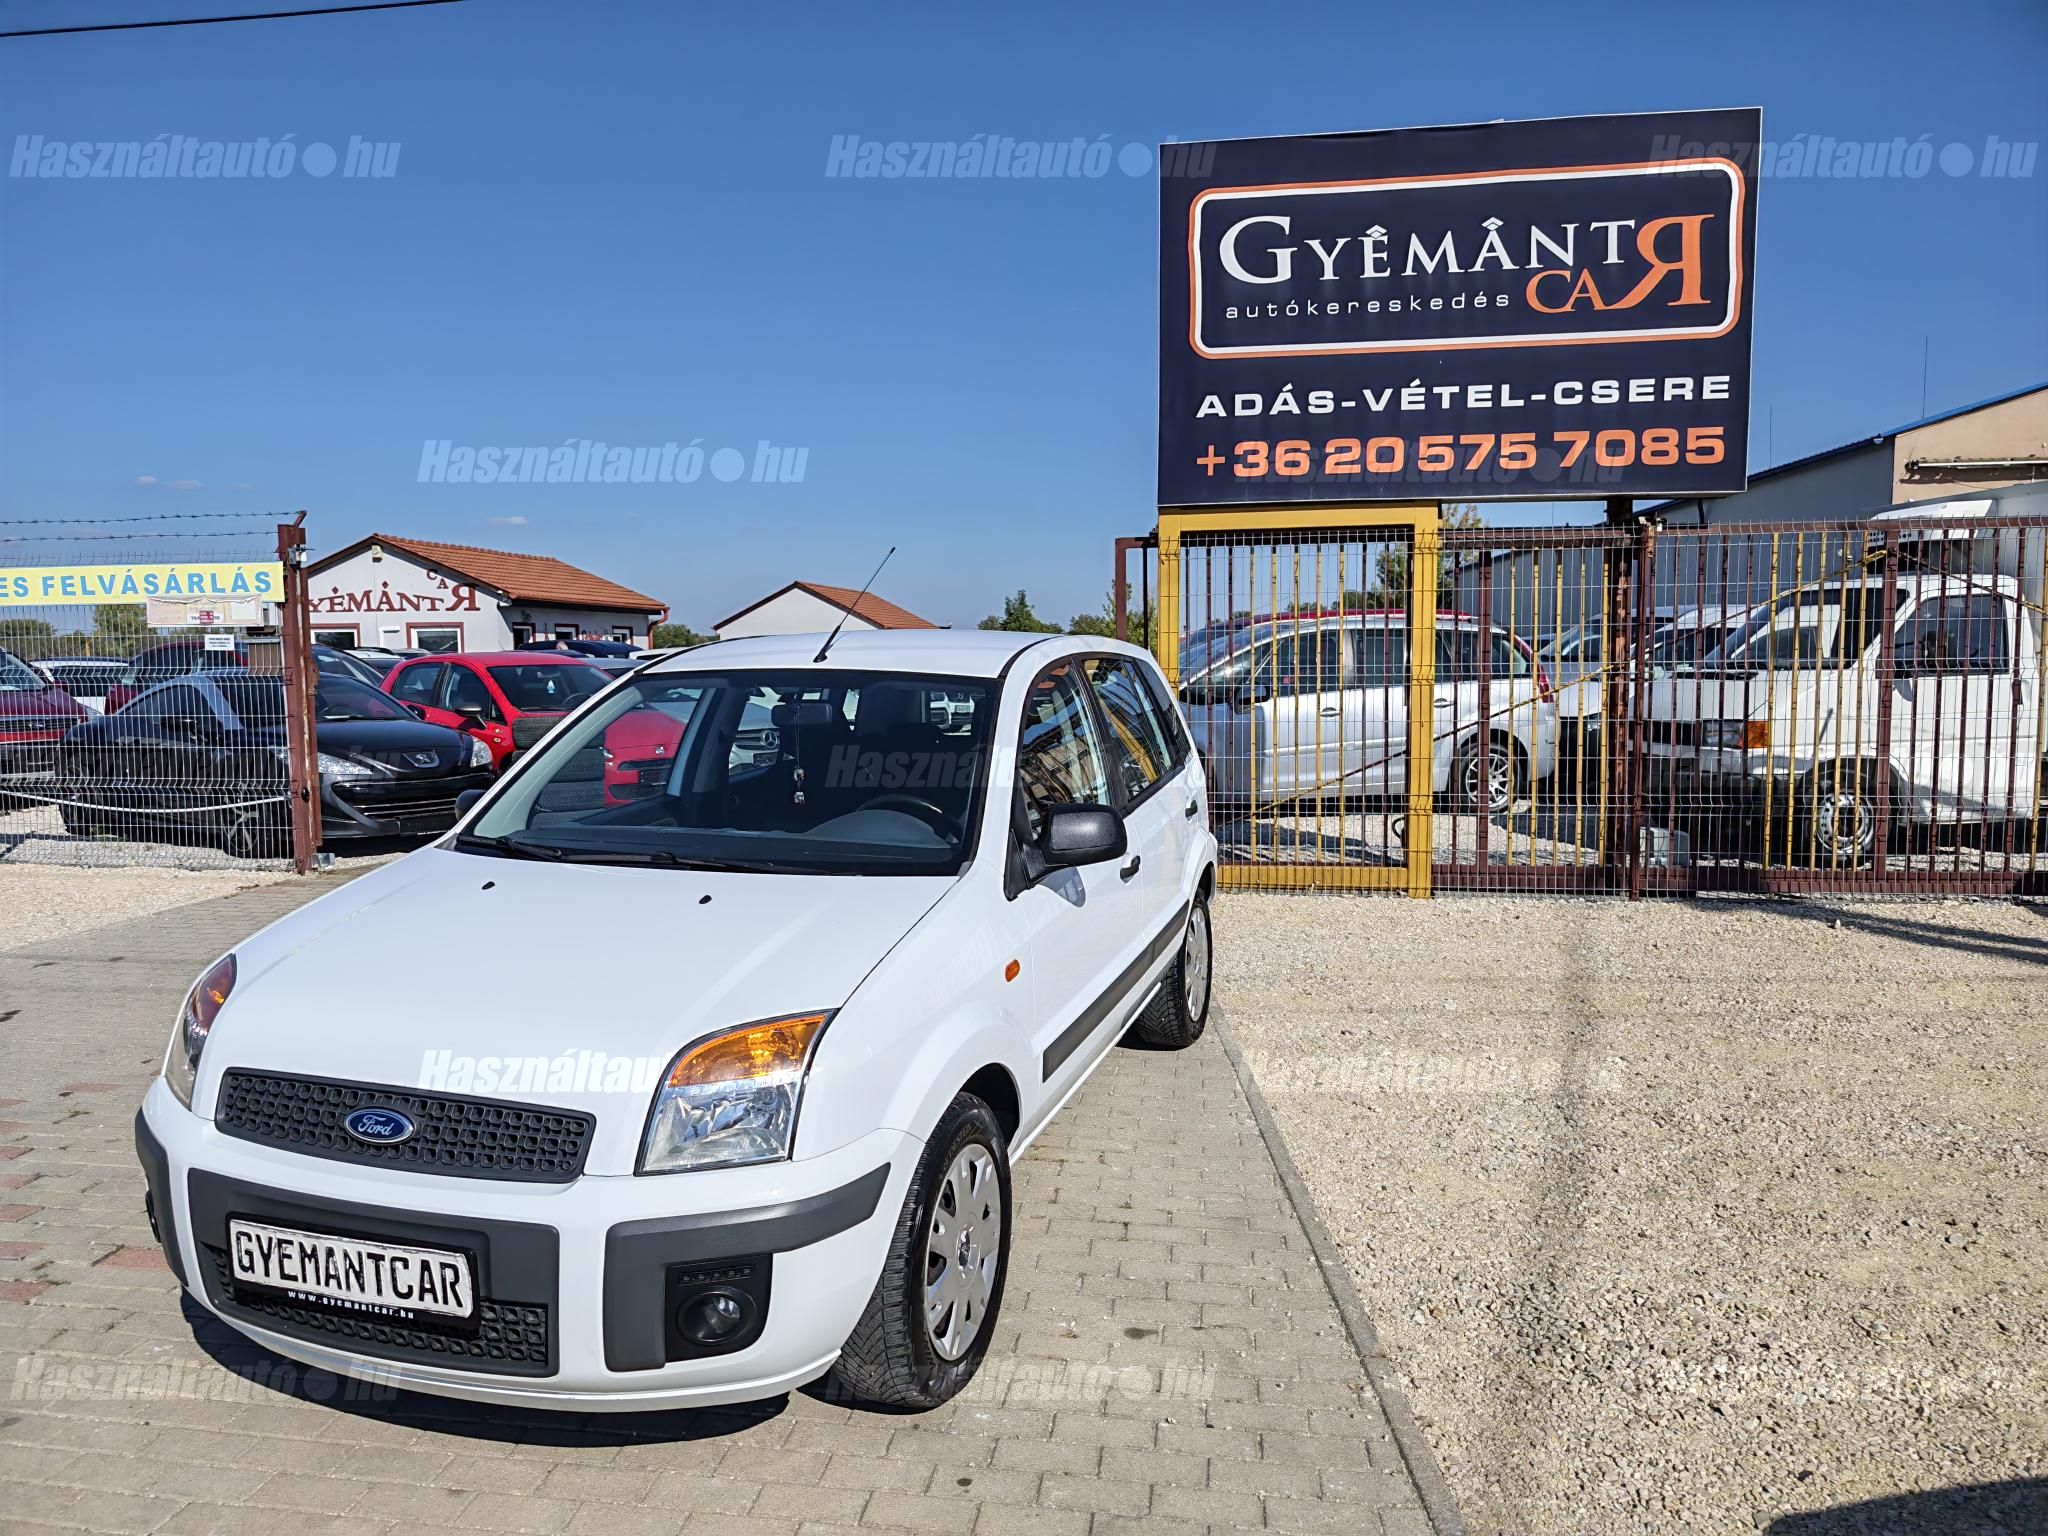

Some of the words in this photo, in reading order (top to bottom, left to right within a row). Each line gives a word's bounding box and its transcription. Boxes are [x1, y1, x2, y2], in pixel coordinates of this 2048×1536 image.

[1225, 293, 1510, 320] autókereskedés
[1552, 427, 1726, 468] 7085
[41, 566, 272, 597] FELVÁSÁRLÁS
[357, 1114, 395, 1137] Ford
[235, 1231, 464, 1309] GYEMANTCAR
[287, 1290, 415, 1319] www.gyemantcar.hu
